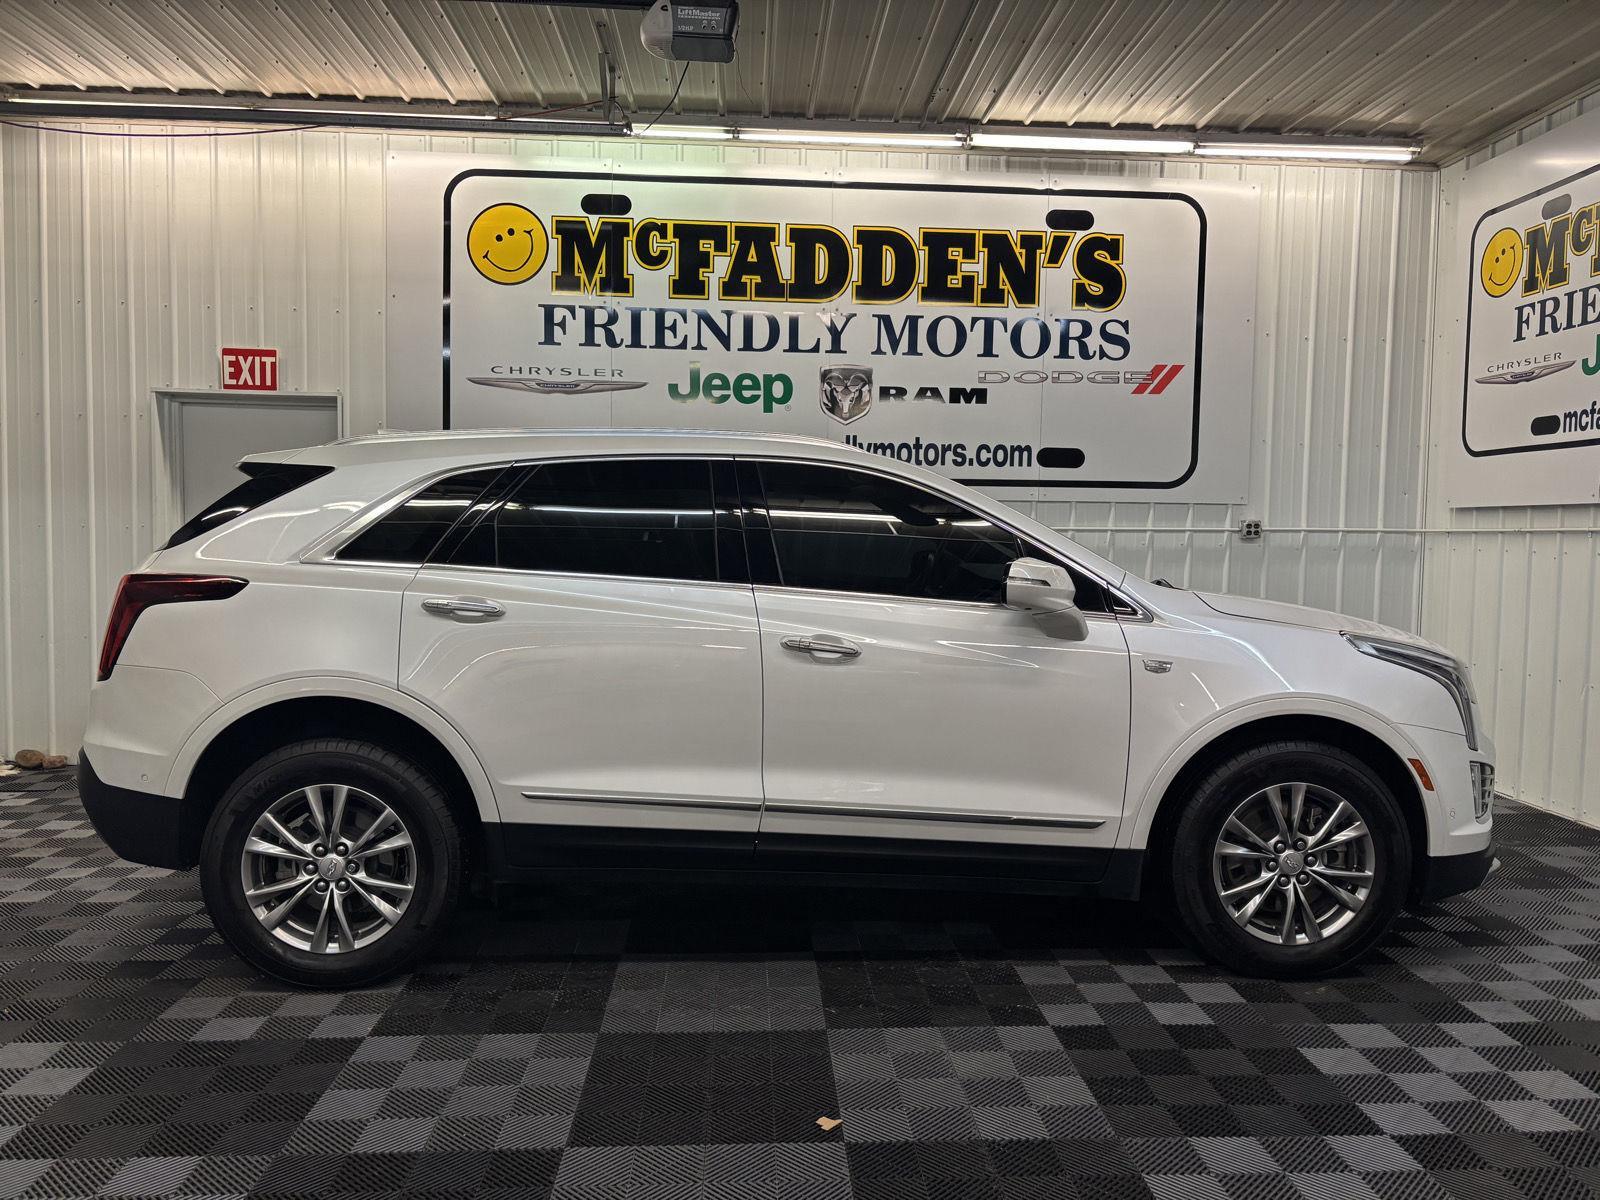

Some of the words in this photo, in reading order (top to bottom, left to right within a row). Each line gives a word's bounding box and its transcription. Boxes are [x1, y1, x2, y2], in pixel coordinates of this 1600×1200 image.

[1521, 203, 1600, 297] Mc
[537, 304, 858, 354] FRIENDLY
[871, 314, 1131, 361] MOTORS
[223, 355, 276, 386] EXIT
[490, 365, 625, 378] CHRYSLER
[1487, 352, 1562, 373] CHRYSLER
[667, 361, 794, 413] Jeep
[978, 370, 1154, 385] DODGE
[878, 385, 988, 405] RAM
